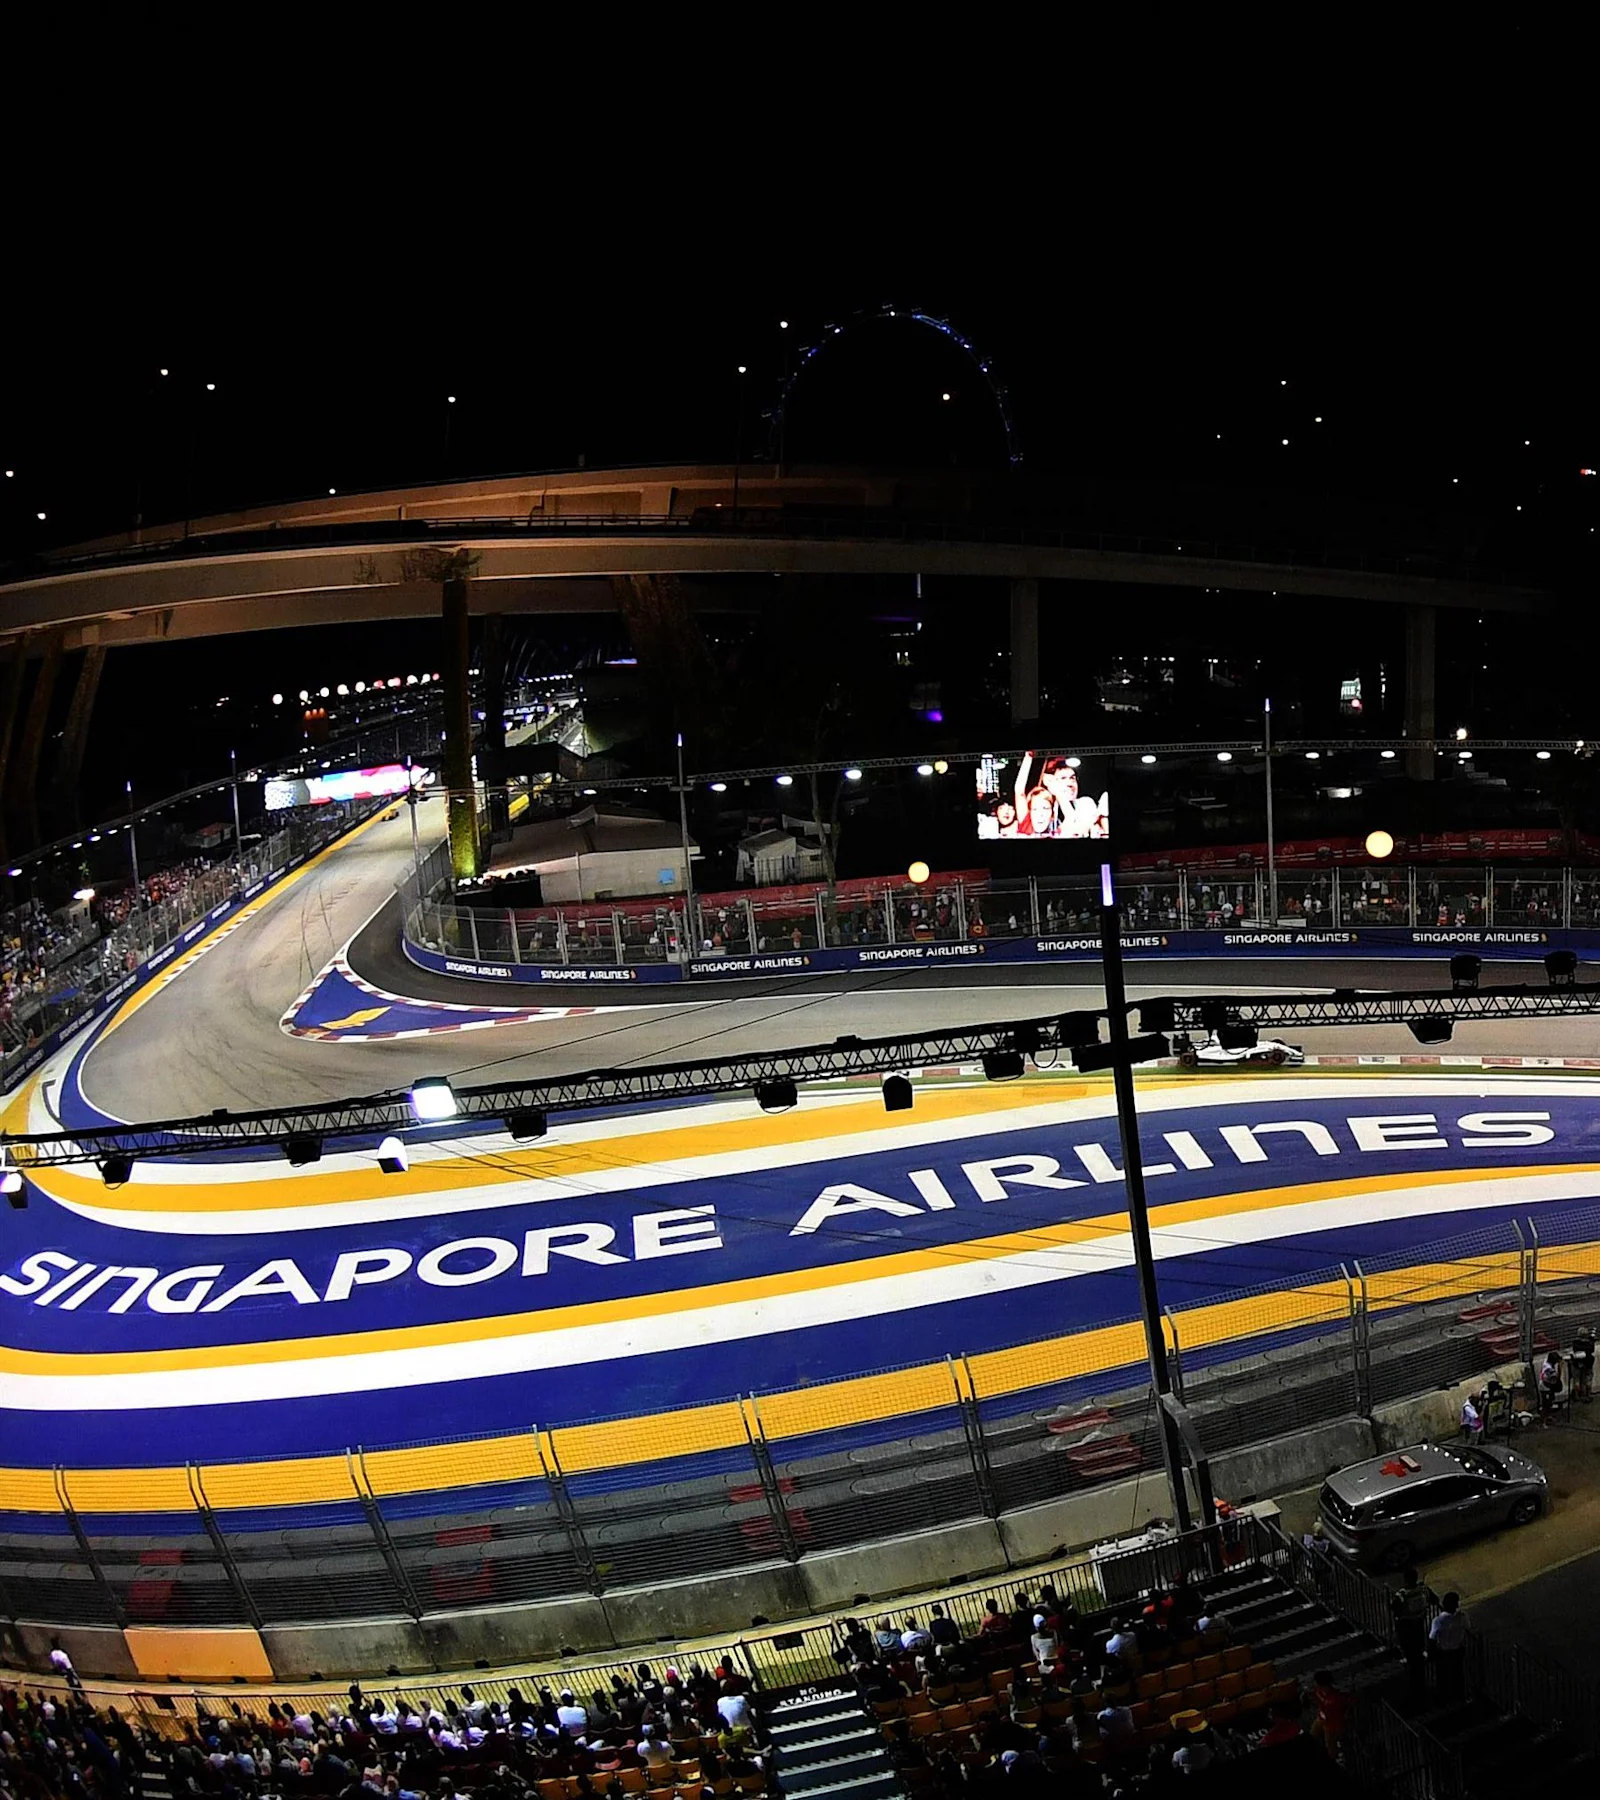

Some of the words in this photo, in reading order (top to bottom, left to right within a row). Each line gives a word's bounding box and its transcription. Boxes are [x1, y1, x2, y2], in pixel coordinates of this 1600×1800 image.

[1037, 939, 1103, 952] SINGAPORE
[1119, 936, 1160, 948] RLINES
[1224, 933, 1292, 945] SINGAPORE
[1295, 932, 1350, 943] AIRLINES
[1412, 932, 1482, 943] SINGAPORE
[1484, 932, 1540, 943] AIRLINES
[859, 947, 924, 961] SINGAPORE
[925, 944, 978, 958] AIRLINES
[445, 961, 478, 975] SINGAPORE
[478, 965, 508, 977] AIRLINES
[691, 959, 752, 973] SINGAPORE
[753, 956, 803, 969] AIRLINES
[541, 969, 588, 980] SINGAPORE
[589, 969, 630, 980] AIRLINES
[0, 1204, 726, 1315] SINGAPORE
[788, 1111, 1557, 1237] AIRLINES
